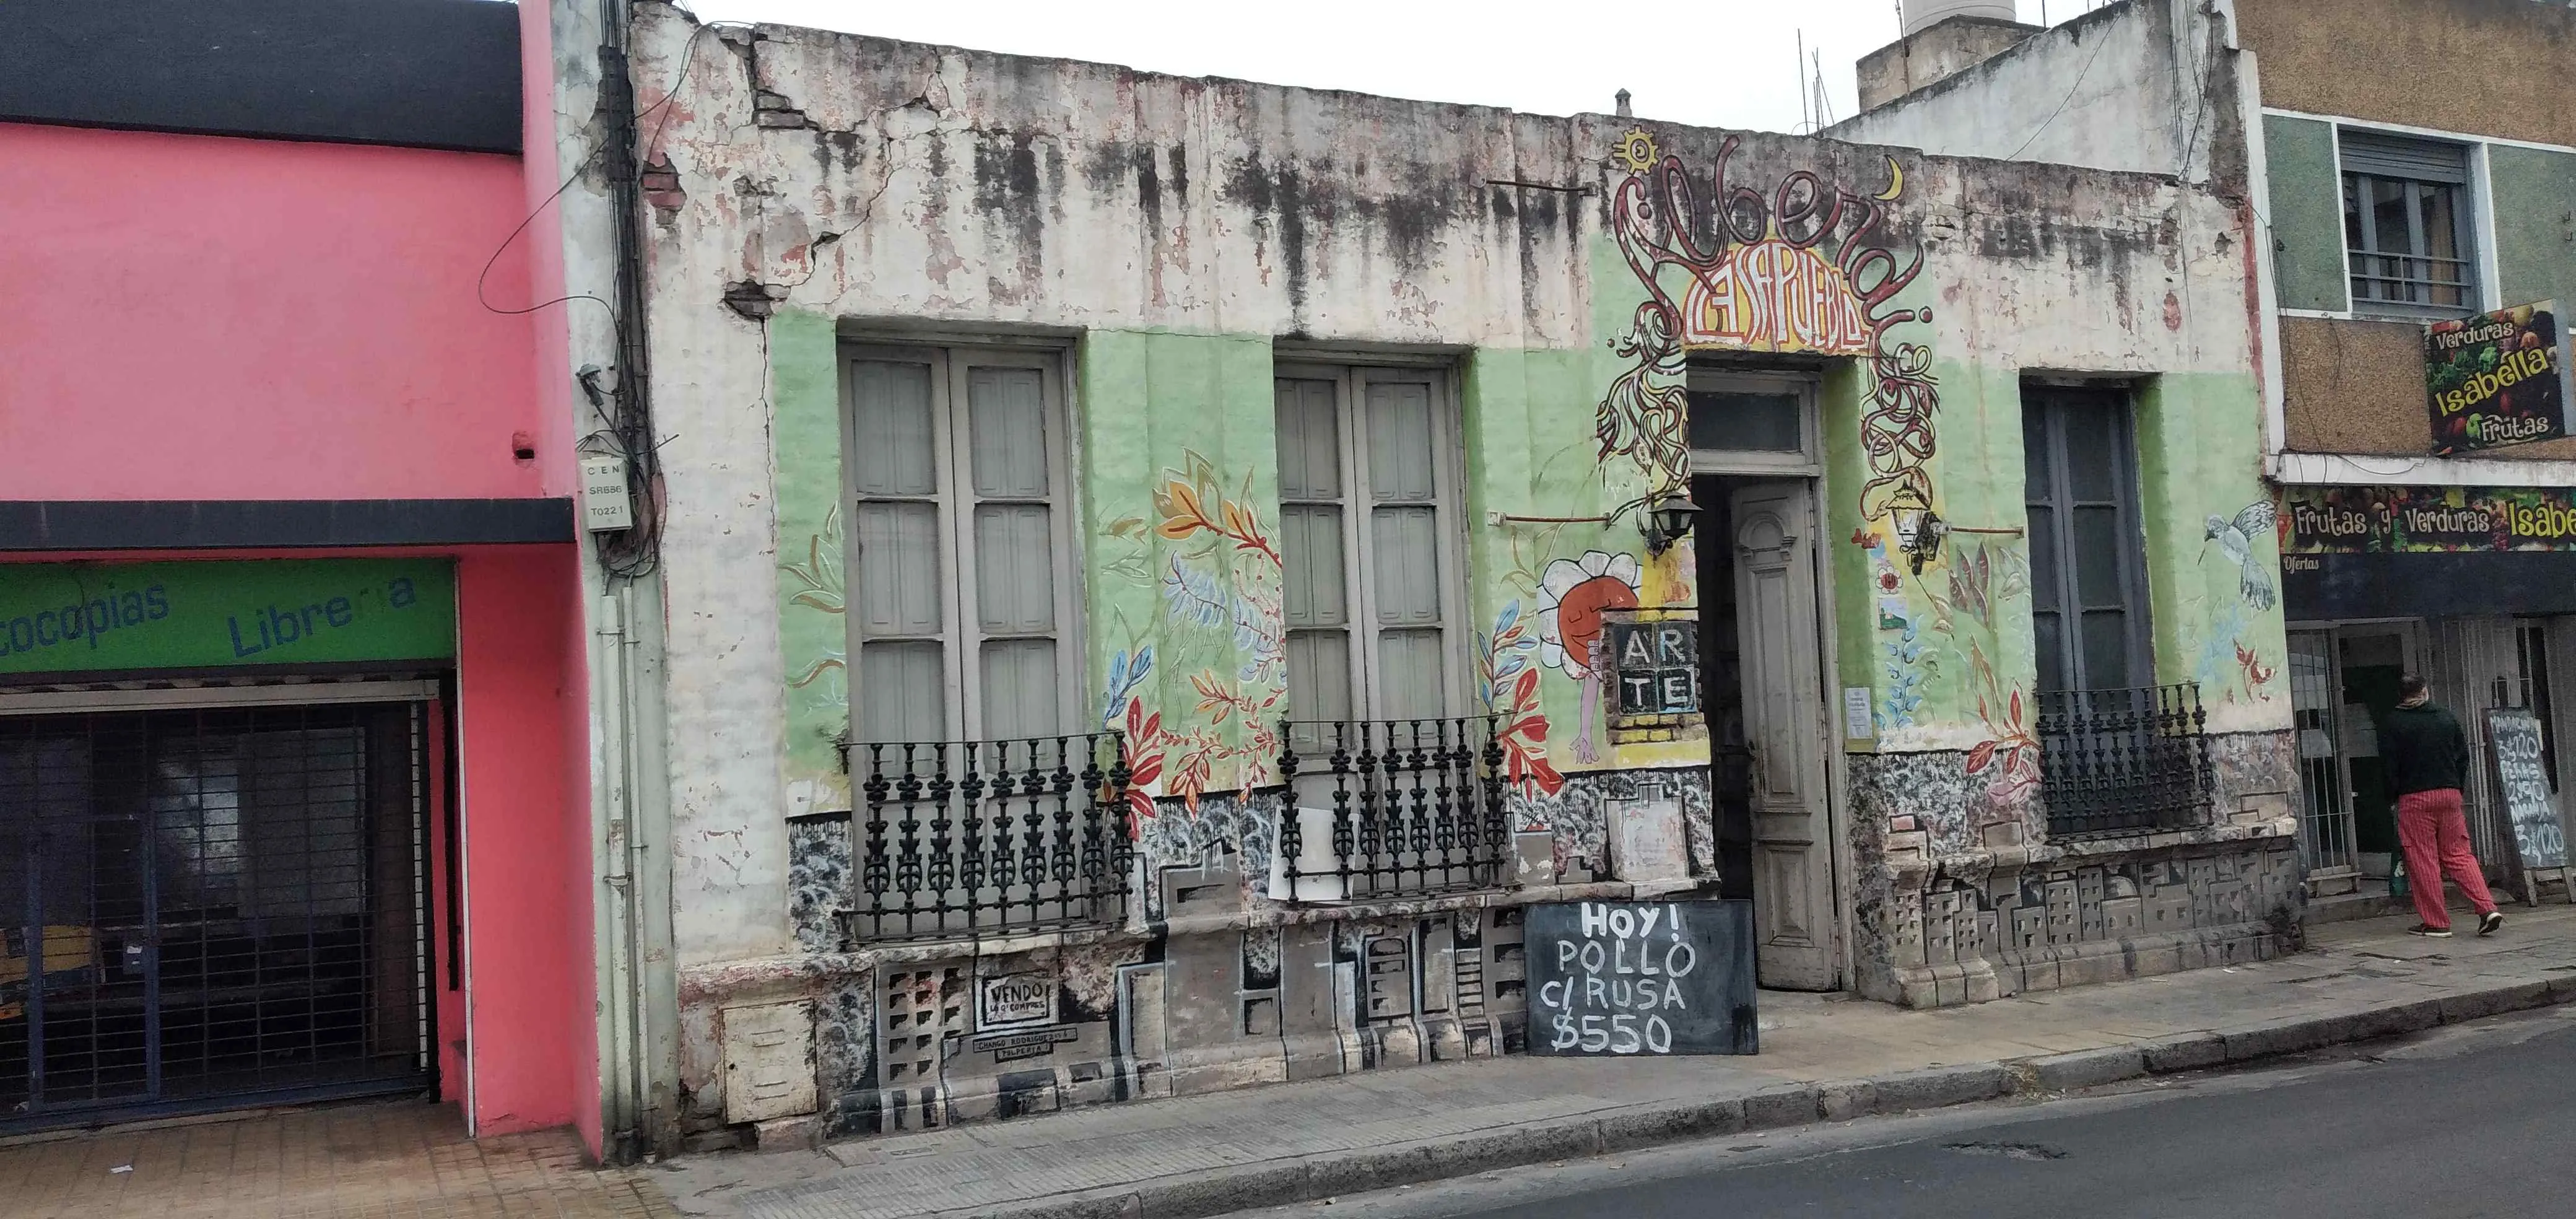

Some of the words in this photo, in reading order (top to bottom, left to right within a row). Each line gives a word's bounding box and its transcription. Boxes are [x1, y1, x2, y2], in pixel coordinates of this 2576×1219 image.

[2435, 321, 2514, 351] Verduras
[2435, 348, 2549, 417] Isabella
[2481, 415, 2549, 442] Frutas
[2294, 503, 2367, 538] Frutas
[2380, 509, 2391, 535] y
[2404, 505, 2490, 533] Verduras
[2283, 555, 2320, 575] Ofertas
[228, 576, 417, 658] Librea
[1624, 676, 1689, 706] TE
[1580, 902, 1680, 942] HOY!
[1557, 939, 1696, 978] POLLO
[1009, 1001, 1046, 1013] COMPRES
[1586, 971, 1686, 1010] RUSA
[1551, 1006, 1673, 1054] $550
